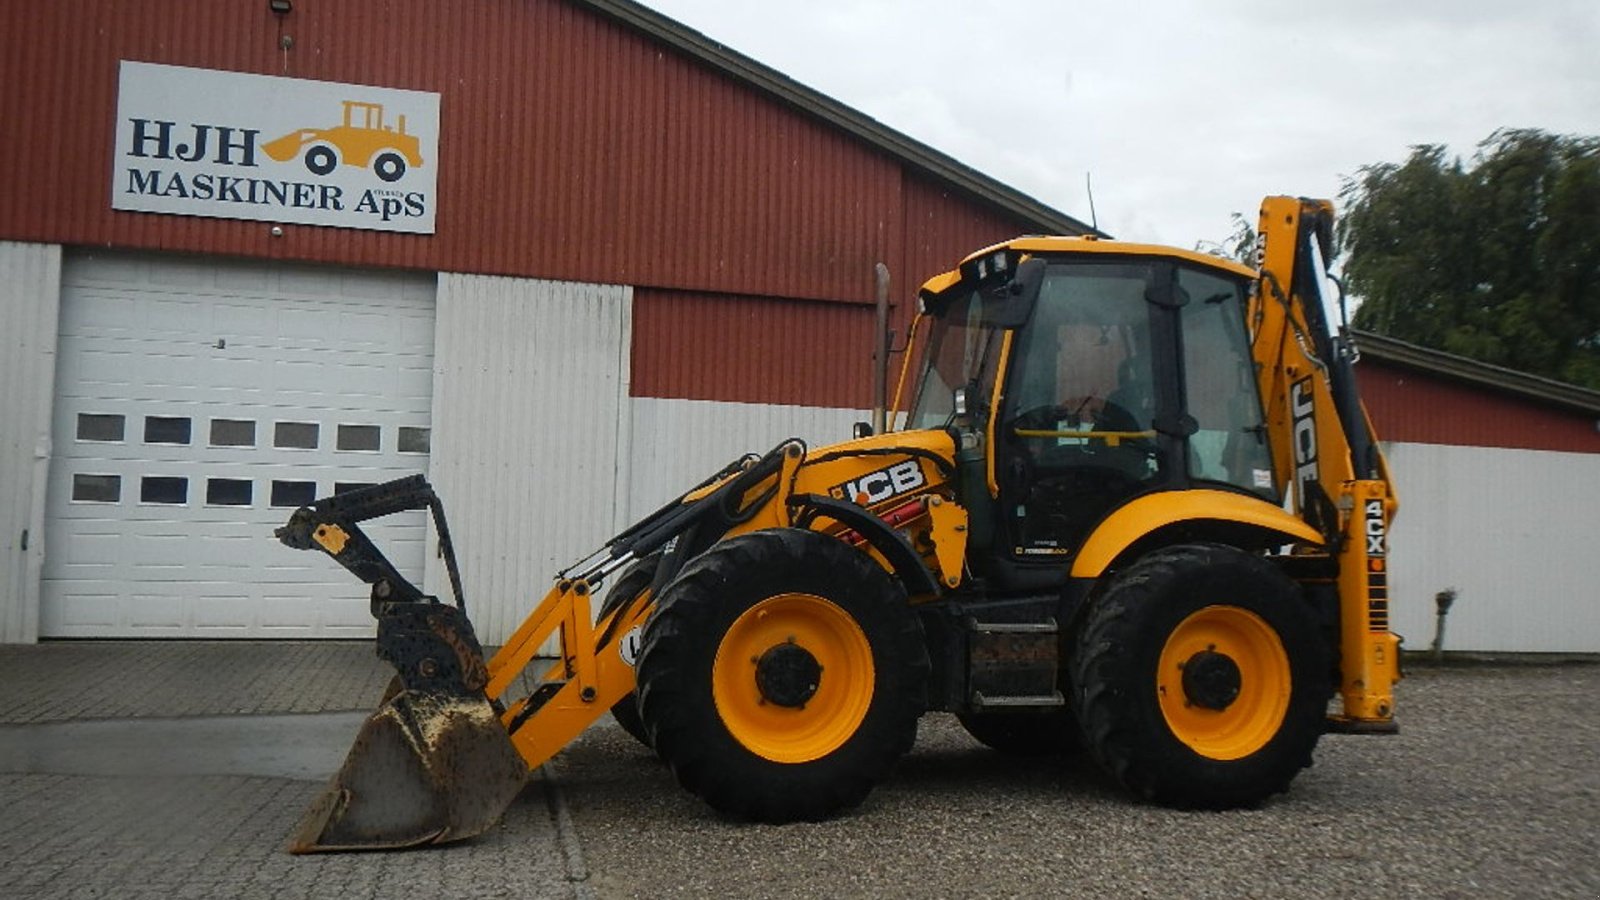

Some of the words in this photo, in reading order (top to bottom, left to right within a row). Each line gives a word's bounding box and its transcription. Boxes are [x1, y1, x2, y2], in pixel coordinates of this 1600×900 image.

[126, 118, 260, 167] HJH
[125, 168, 345, 211] MASKINER
[353, 189, 426, 221] ApS
[846, 460, 924, 504] JCB
[1366, 501, 1385, 553] 4CX
